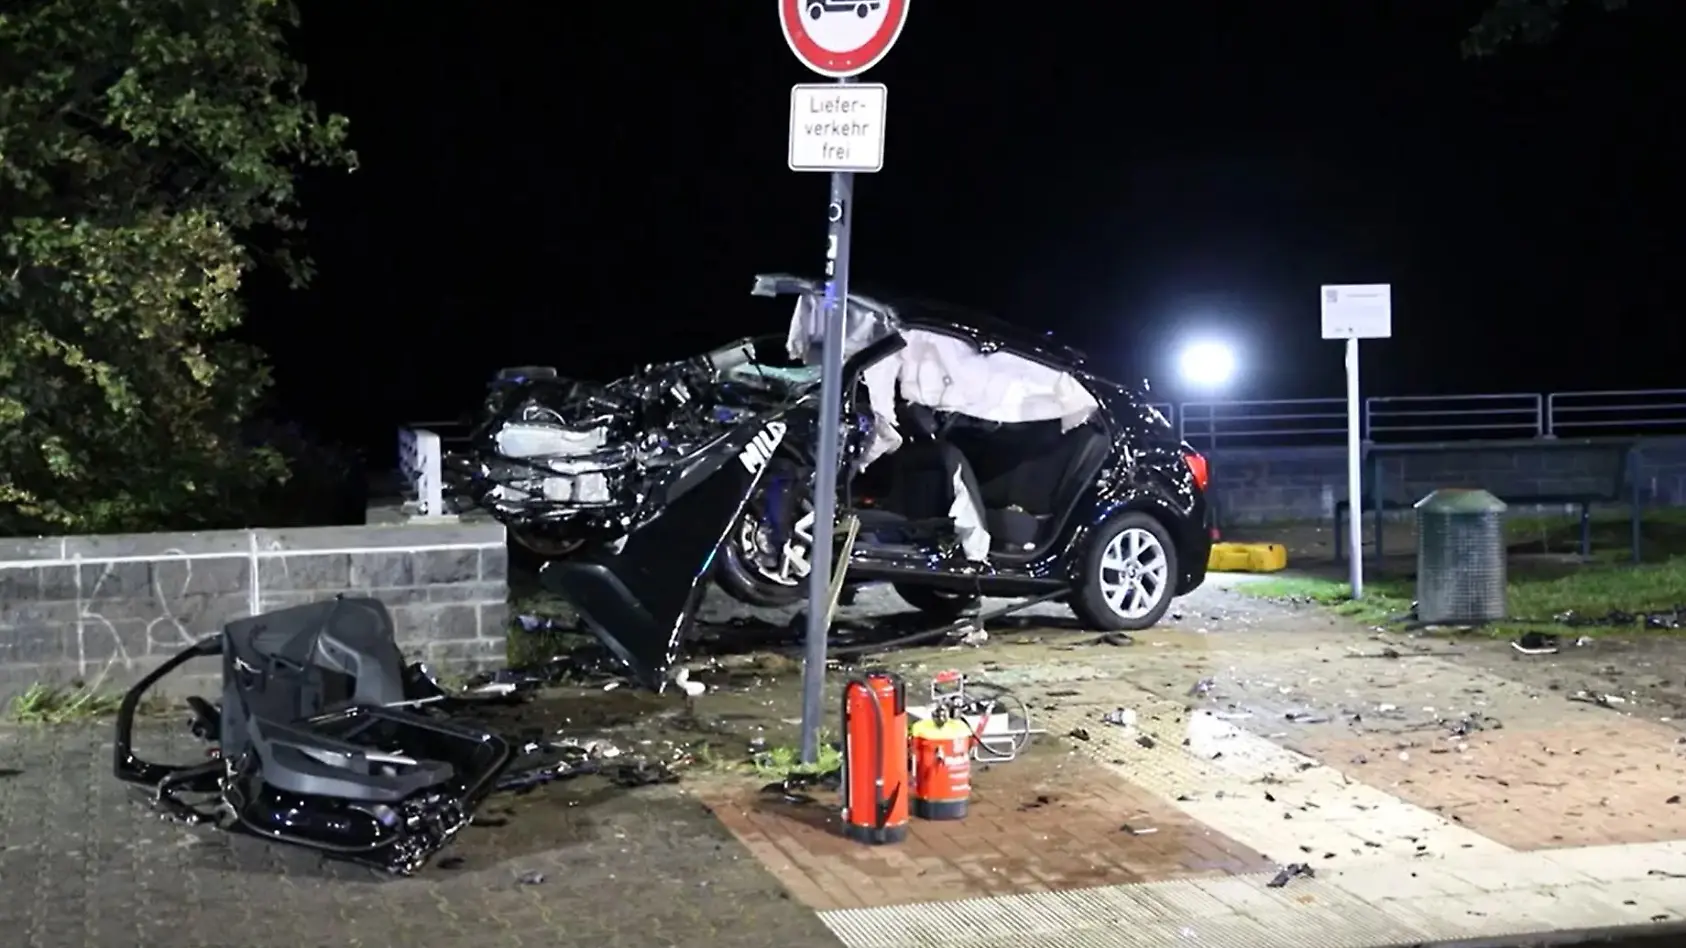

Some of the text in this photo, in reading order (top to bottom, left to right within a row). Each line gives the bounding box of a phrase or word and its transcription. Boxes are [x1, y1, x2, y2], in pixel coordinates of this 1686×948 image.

[809, 95, 867, 114] Liefer-
[804, 119, 870, 136] verkehr
[821, 141, 851, 160] frei
